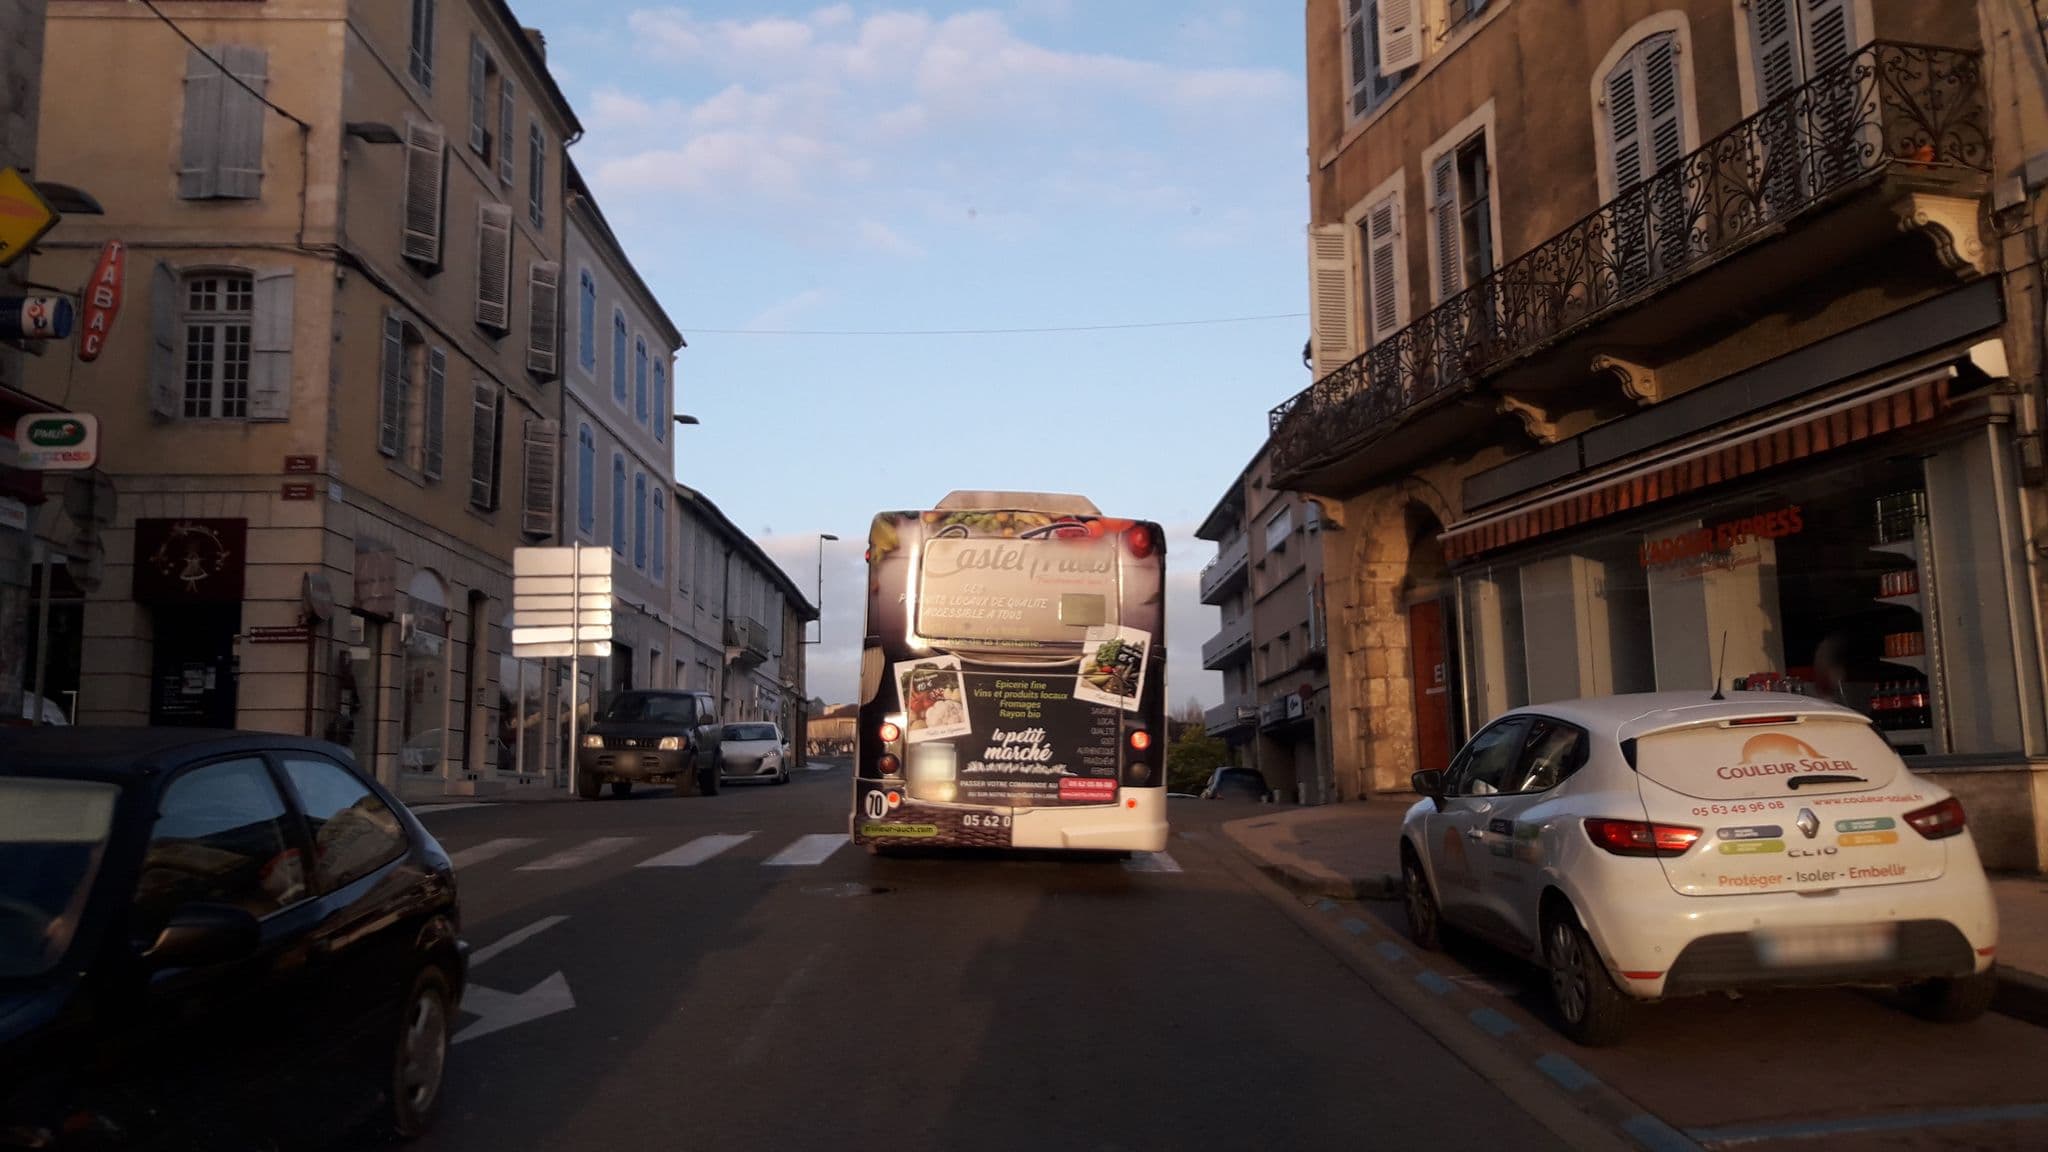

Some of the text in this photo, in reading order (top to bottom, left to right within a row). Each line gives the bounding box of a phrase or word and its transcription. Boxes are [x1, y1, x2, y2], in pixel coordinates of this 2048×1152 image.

[86, 242, 121, 354] TABAC
[1718, 507, 1803, 548] EXPRESS
[1030, 680, 1047, 689] fine
[974, 689, 992, 697] Vins
[1004, 690, 1039, 699] produits
[1040, 691, 1069, 700] locaux
[1000, 700, 1042, 709] Fromages
[1000, 709, 1041, 719] Rayon bio
[992, 726, 1046, 747] le petit
[984, 743, 1054, 761] marché
[1716, 758, 1858, 781] COULEUR SOLEIL
[986, 780, 1008, 788] VOTRE
[1009, 781, 1047, 789] COMMANDE
[869, 794, 883, 816] 70
[1692, 799, 1785, 817] 05 63 49 96 08
[963, 815, 980, 826] 05
[983, 816, 999, 827] 62
[1787, 847, 1838, 858] CLIO
[1796, 869, 1836, 883] Isoler
[1849, 864, 1907, 880] Embellir
